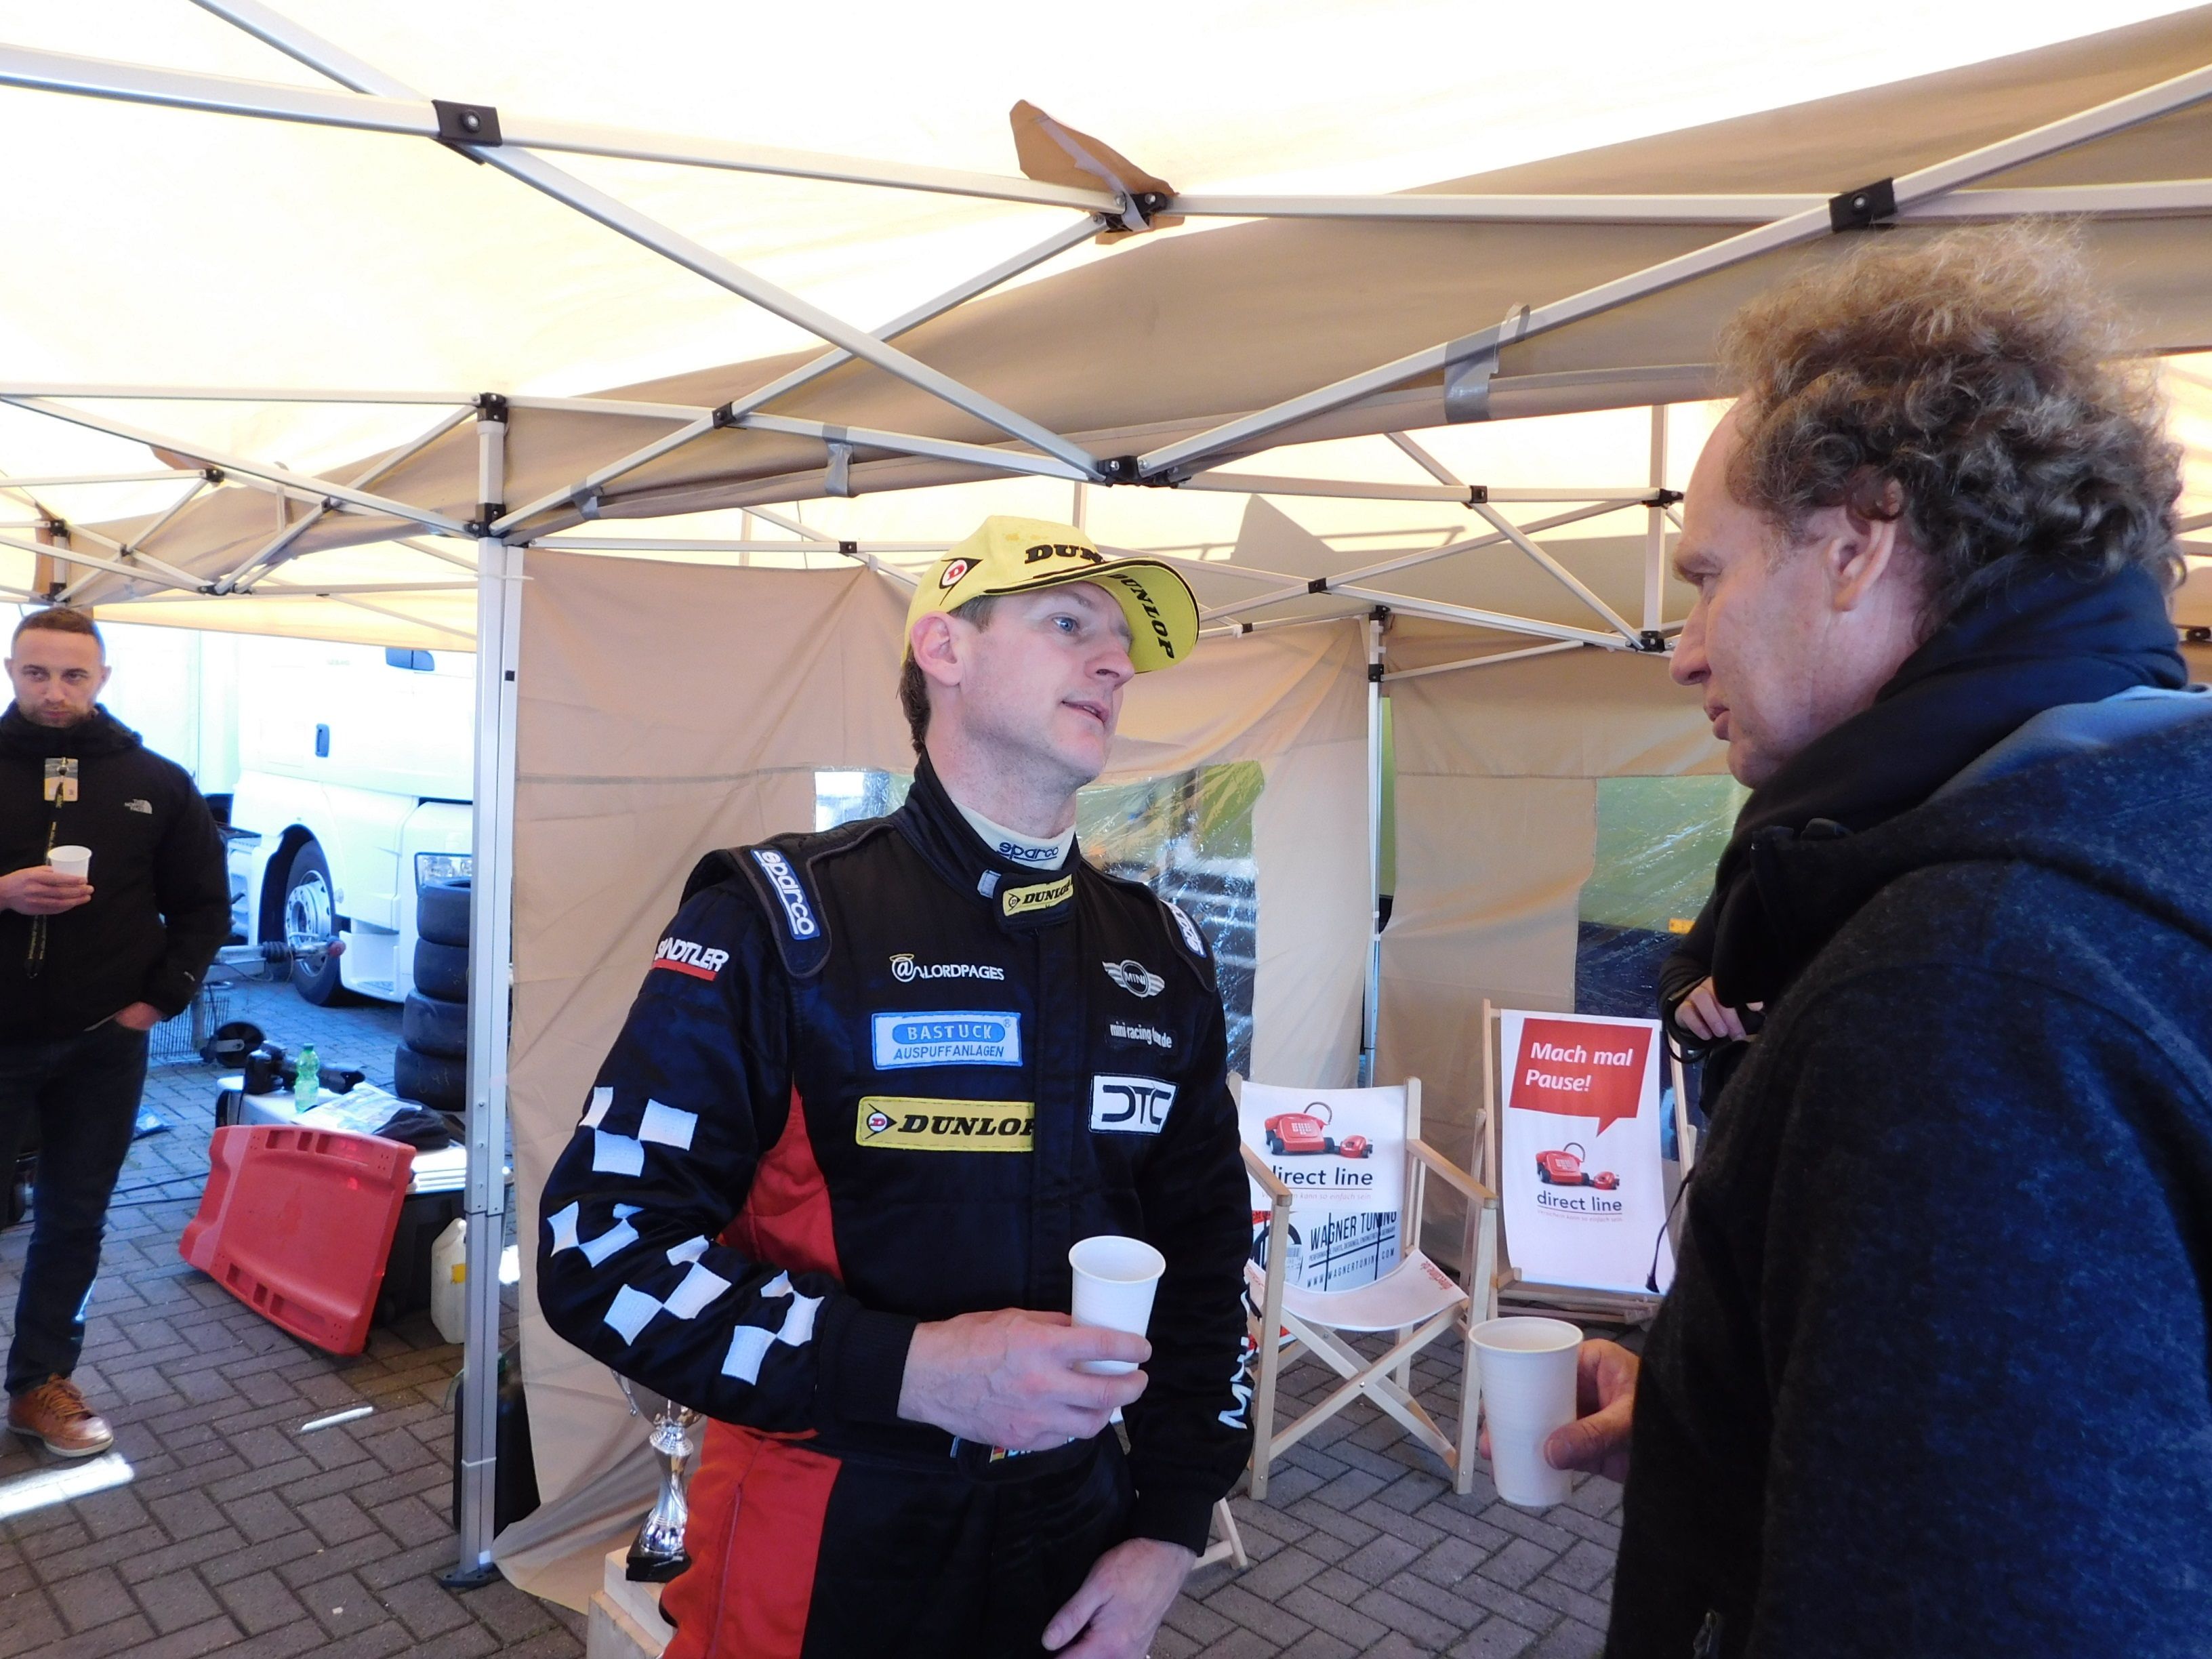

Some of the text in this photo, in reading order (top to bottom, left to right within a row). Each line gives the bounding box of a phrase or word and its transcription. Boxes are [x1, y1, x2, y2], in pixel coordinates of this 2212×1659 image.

[1107, 573, 1175, 659] DUNLOP
[998, 842, 1059, 860] sparco
[760, 851, 815, 935] sparco
[1123, 971, 1147, 986] MINI
[907, 1025, 993, 1041] BASTUCK
[893, 1044, 1005, 1061] AUSPUFFANLAGEN
[1530, 1042, 1633, 1067] Mach mal
[1525, 1069, 1592, 1092] Pause!
[1101, 1084, 1172, 1126] DTC
[1334, 1167, 1373, 1186] line
[1537, 1190, 1622, 1212] direct line
[1311, 1215, 1357, 1251] WAGNER
